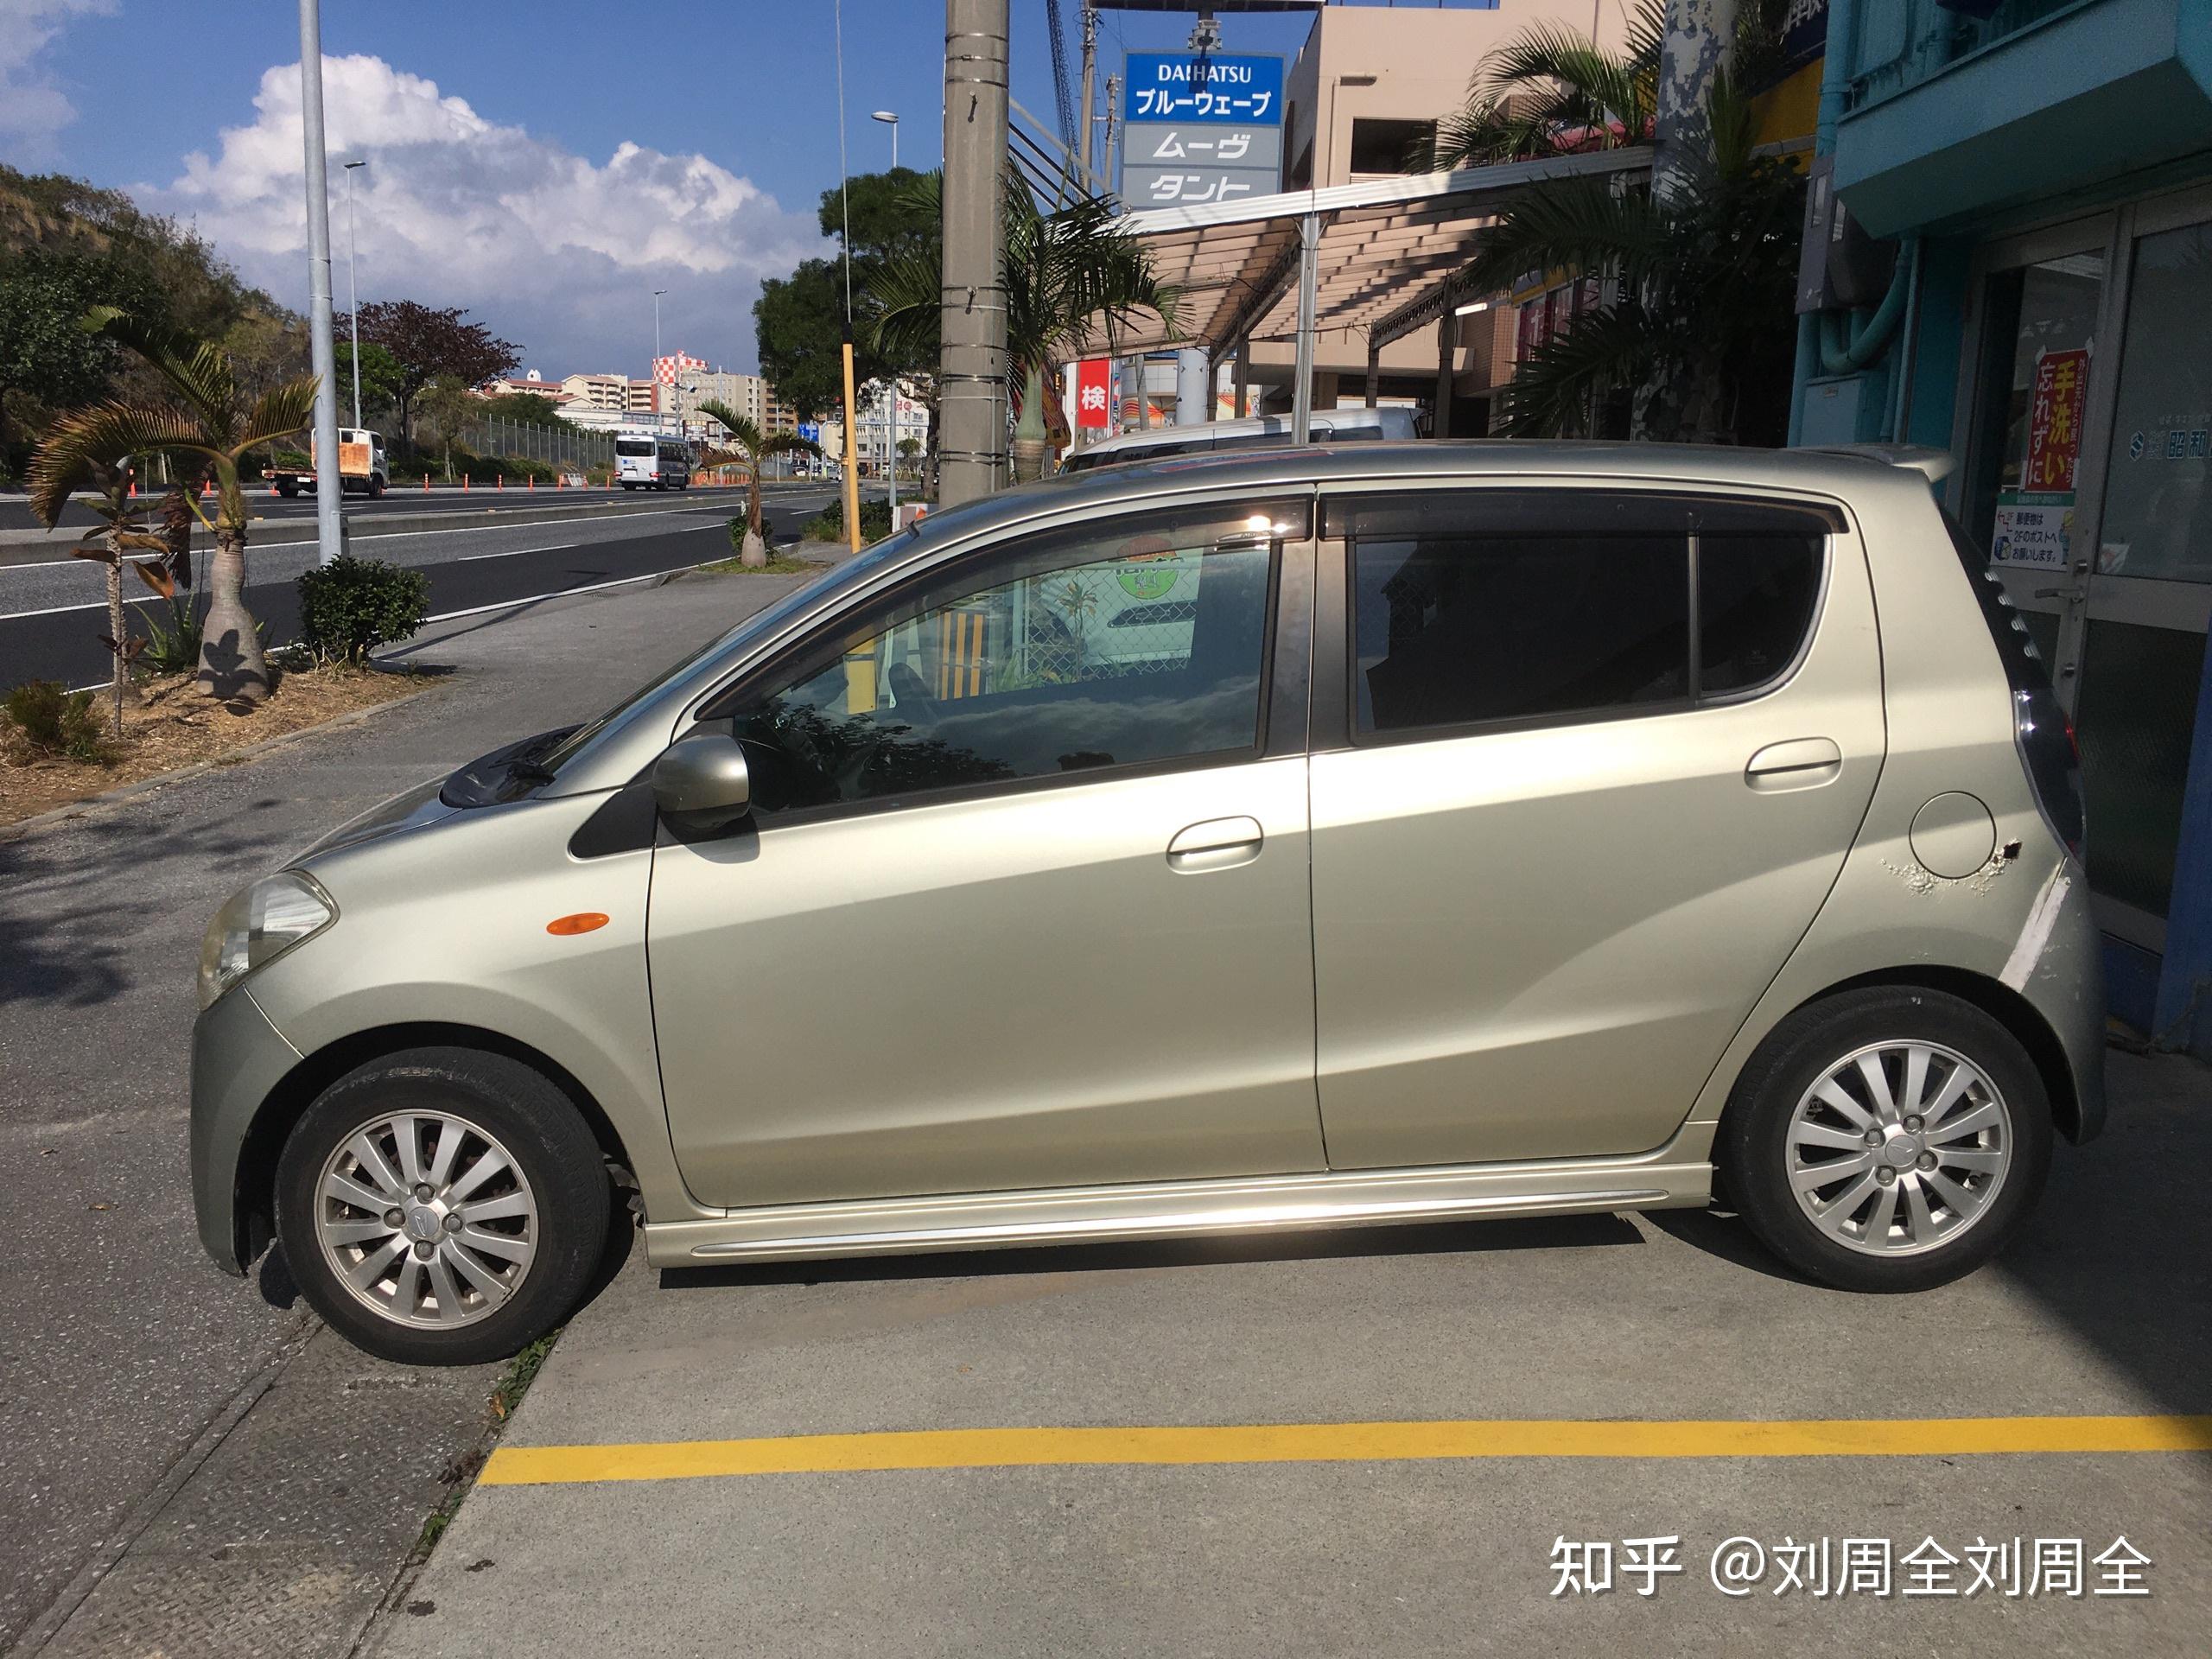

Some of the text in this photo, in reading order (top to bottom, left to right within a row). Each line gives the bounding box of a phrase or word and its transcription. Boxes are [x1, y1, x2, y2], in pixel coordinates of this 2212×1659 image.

[1158, 64, 1251, 84] DAIHATSU
[1135, 88, 1272, 118] ブルーウェーブ
[1152, 132, 1251, 159] ムーヴ
[1149, 175, 1250, 201] タント
[1081, 385, 1106, 410] 検
[2027, 362, 2056, 485] 忘れずに
[2044, 359, 2075, 485] 手洗い
[2166, 429, 2212, 460] 昭和
